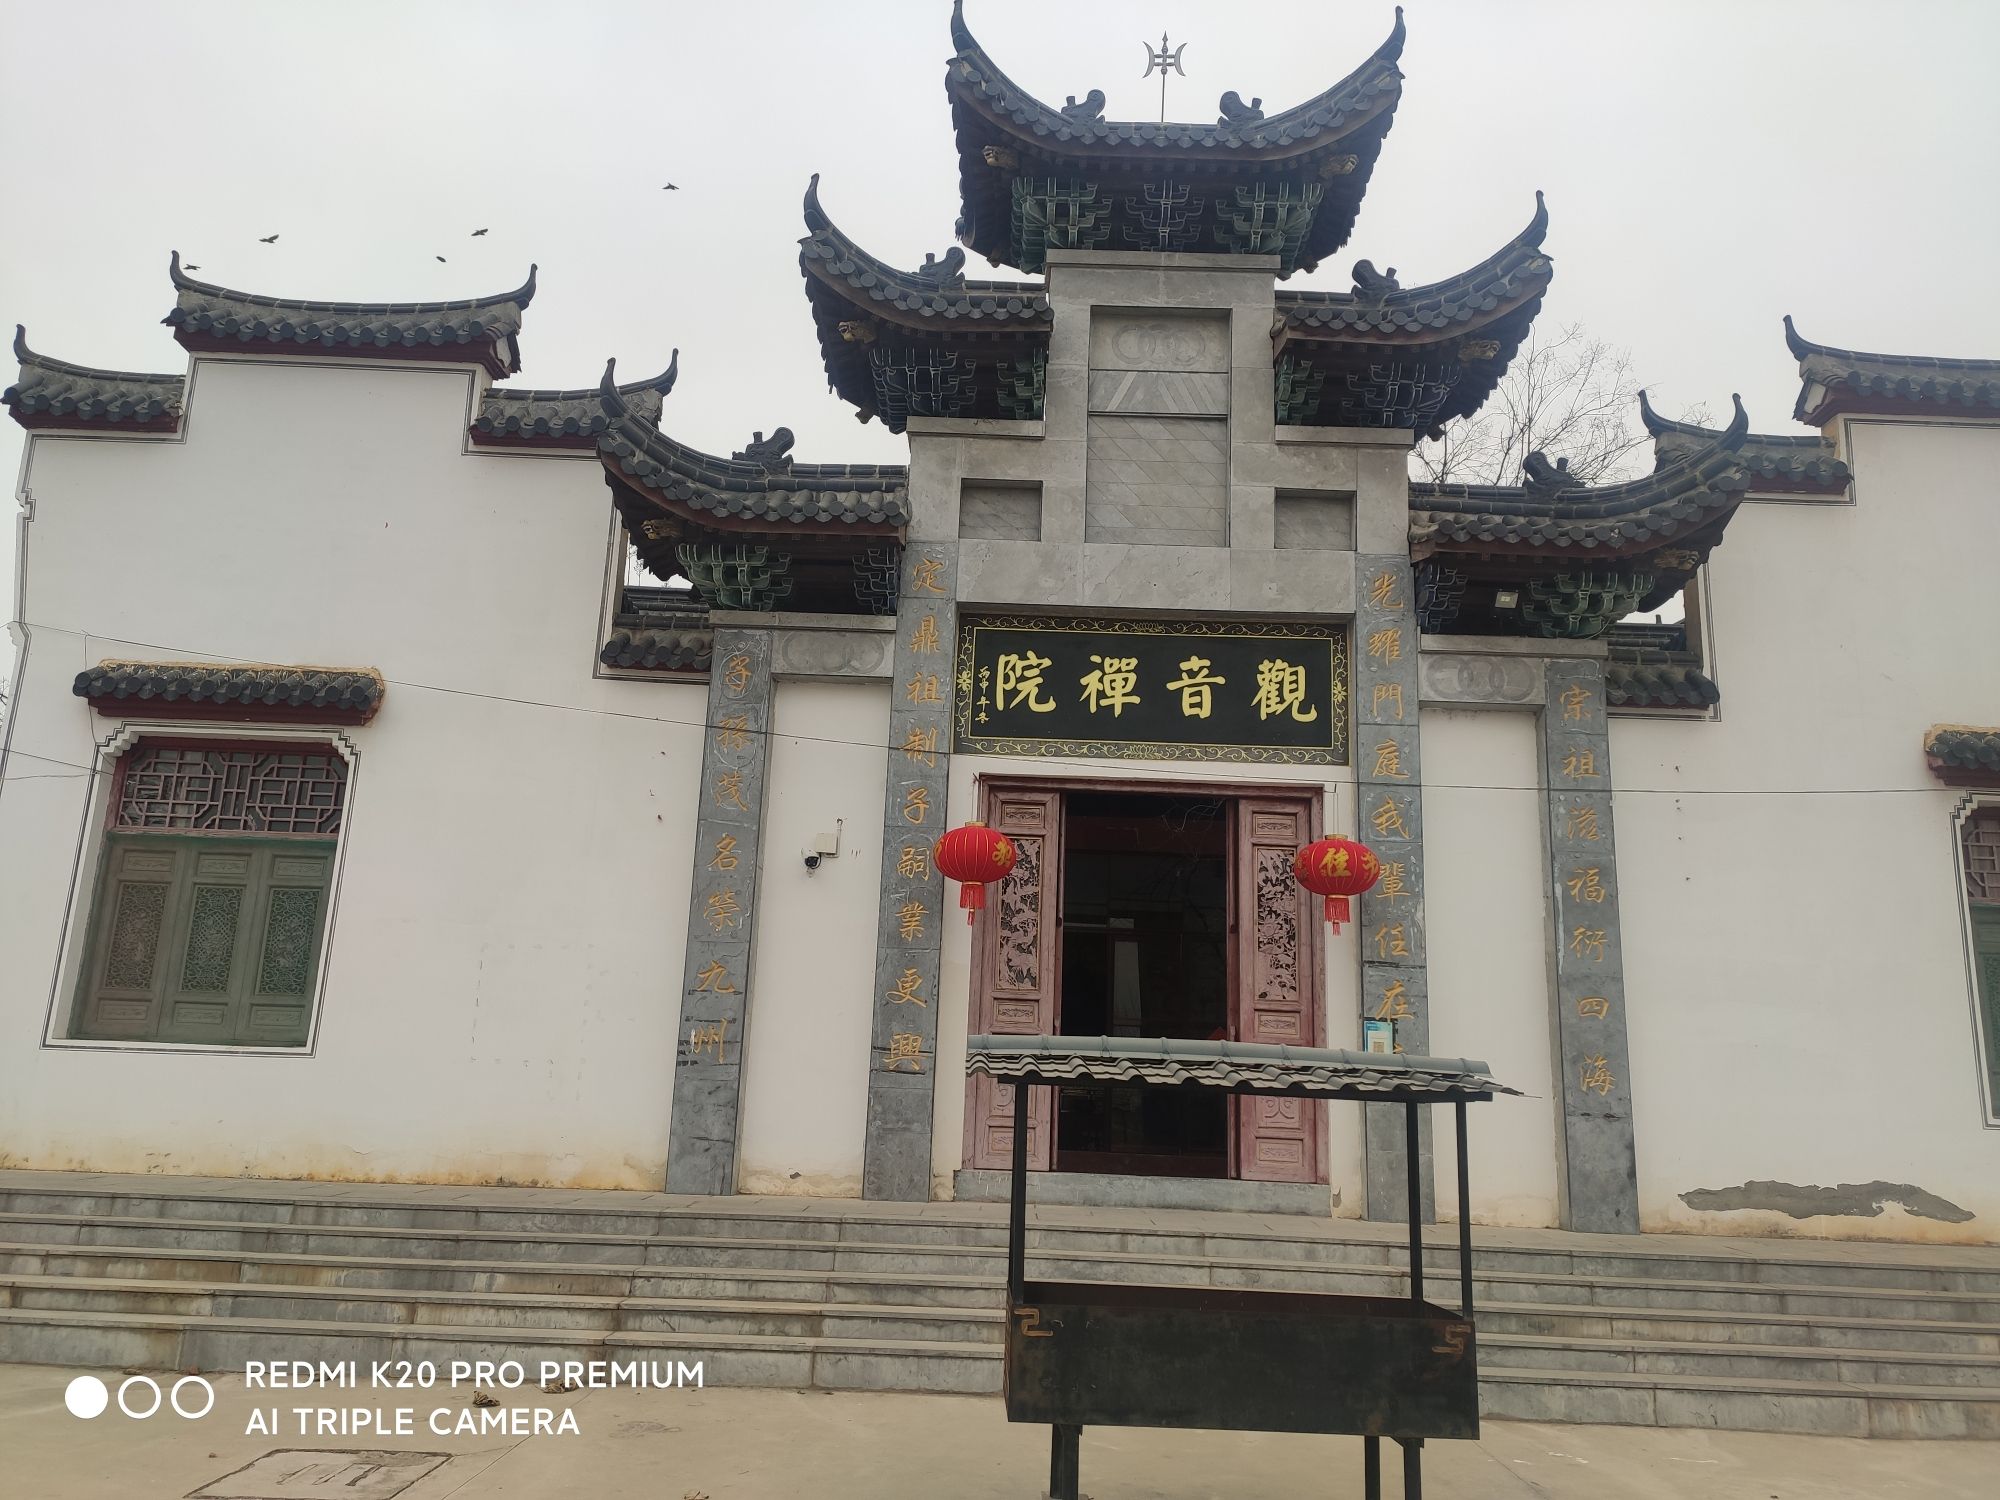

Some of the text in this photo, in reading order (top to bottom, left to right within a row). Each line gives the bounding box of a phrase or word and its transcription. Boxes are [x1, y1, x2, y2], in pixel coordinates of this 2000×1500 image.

[1368, 573, 1415, 1055] 光耀門庭我輩任在
